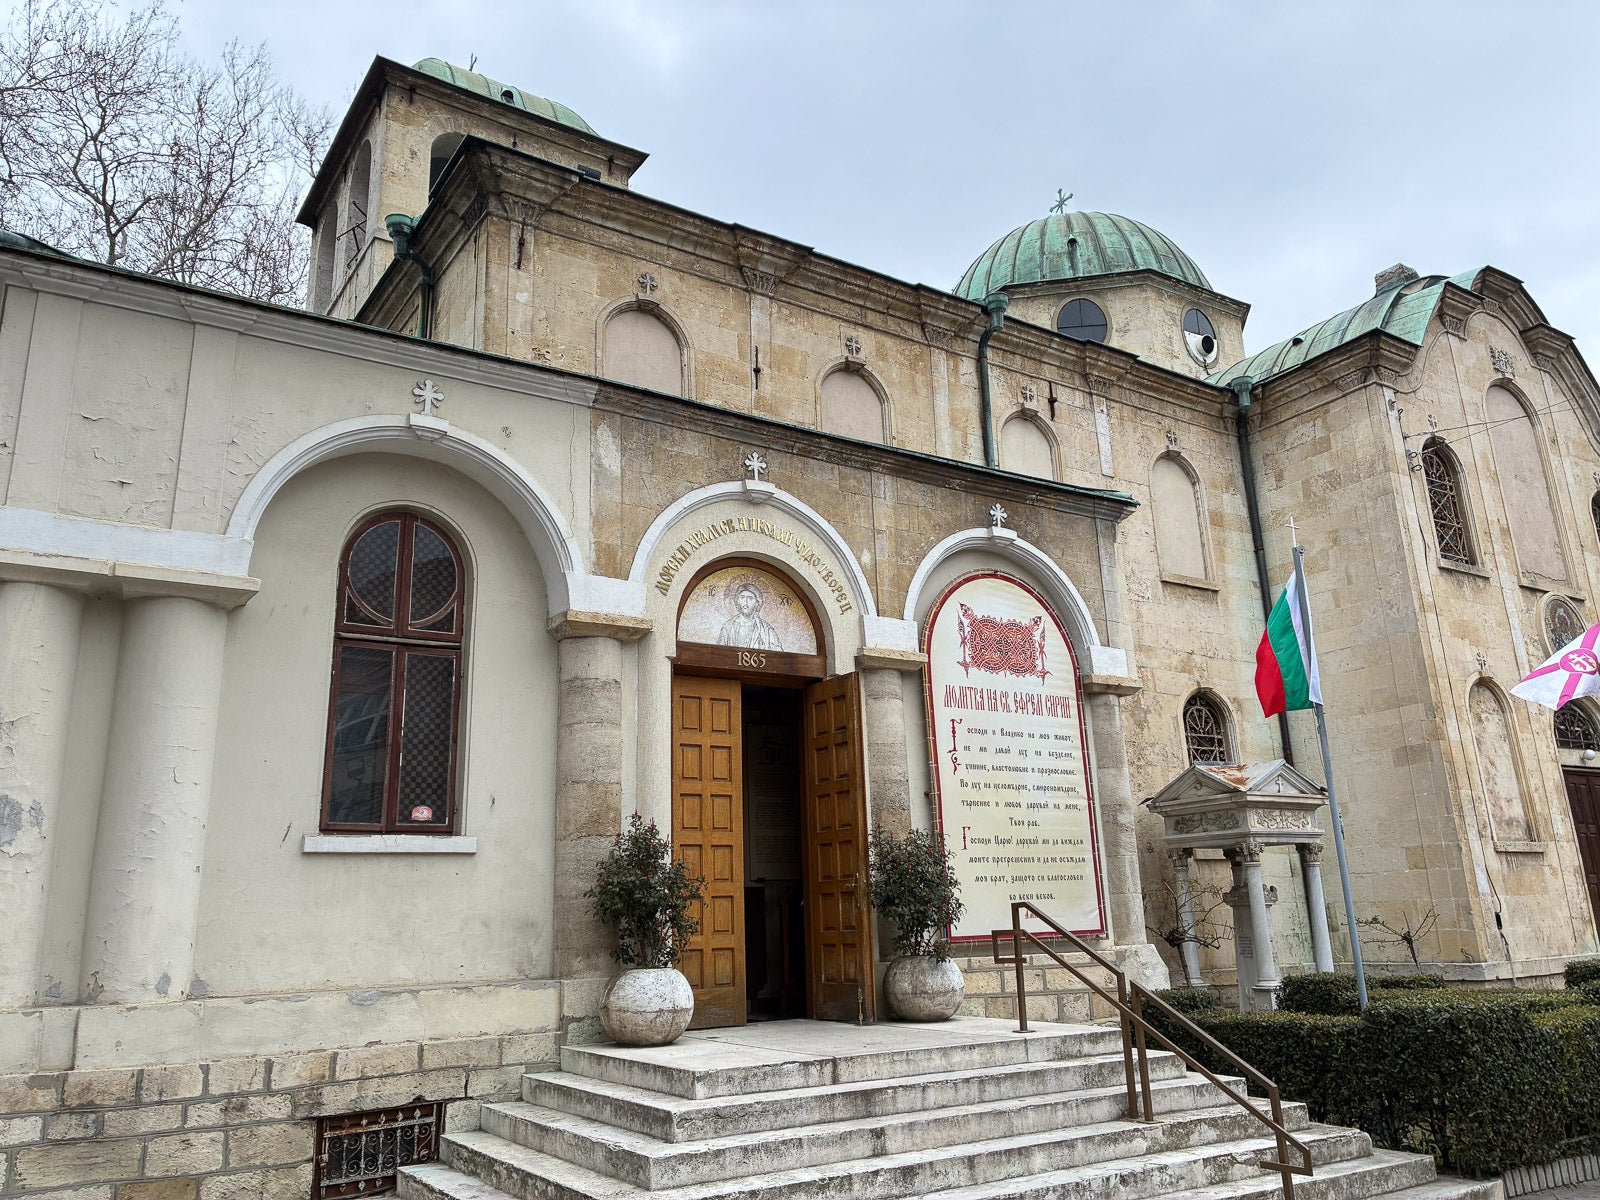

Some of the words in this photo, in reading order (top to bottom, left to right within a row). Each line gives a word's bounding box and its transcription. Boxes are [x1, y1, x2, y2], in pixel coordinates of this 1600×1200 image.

[655, 544, 692, 596] МОРСКИ
[685, 524, 722, 552] ХРАМ
[738, 516, 794, 547] НИКОЛАЙ
[795, 538, 852, 616] ЧУДОТВОРЕЦ
[737, 652, 766, 668] 1865
[944, 684, 985, 710] МОЛИТВА
[986, 689, 998, 712] НА
[1014, 691, 1044, 716] ЕФРЕМ
[1045, 694, 1072, 718] СИРИН
